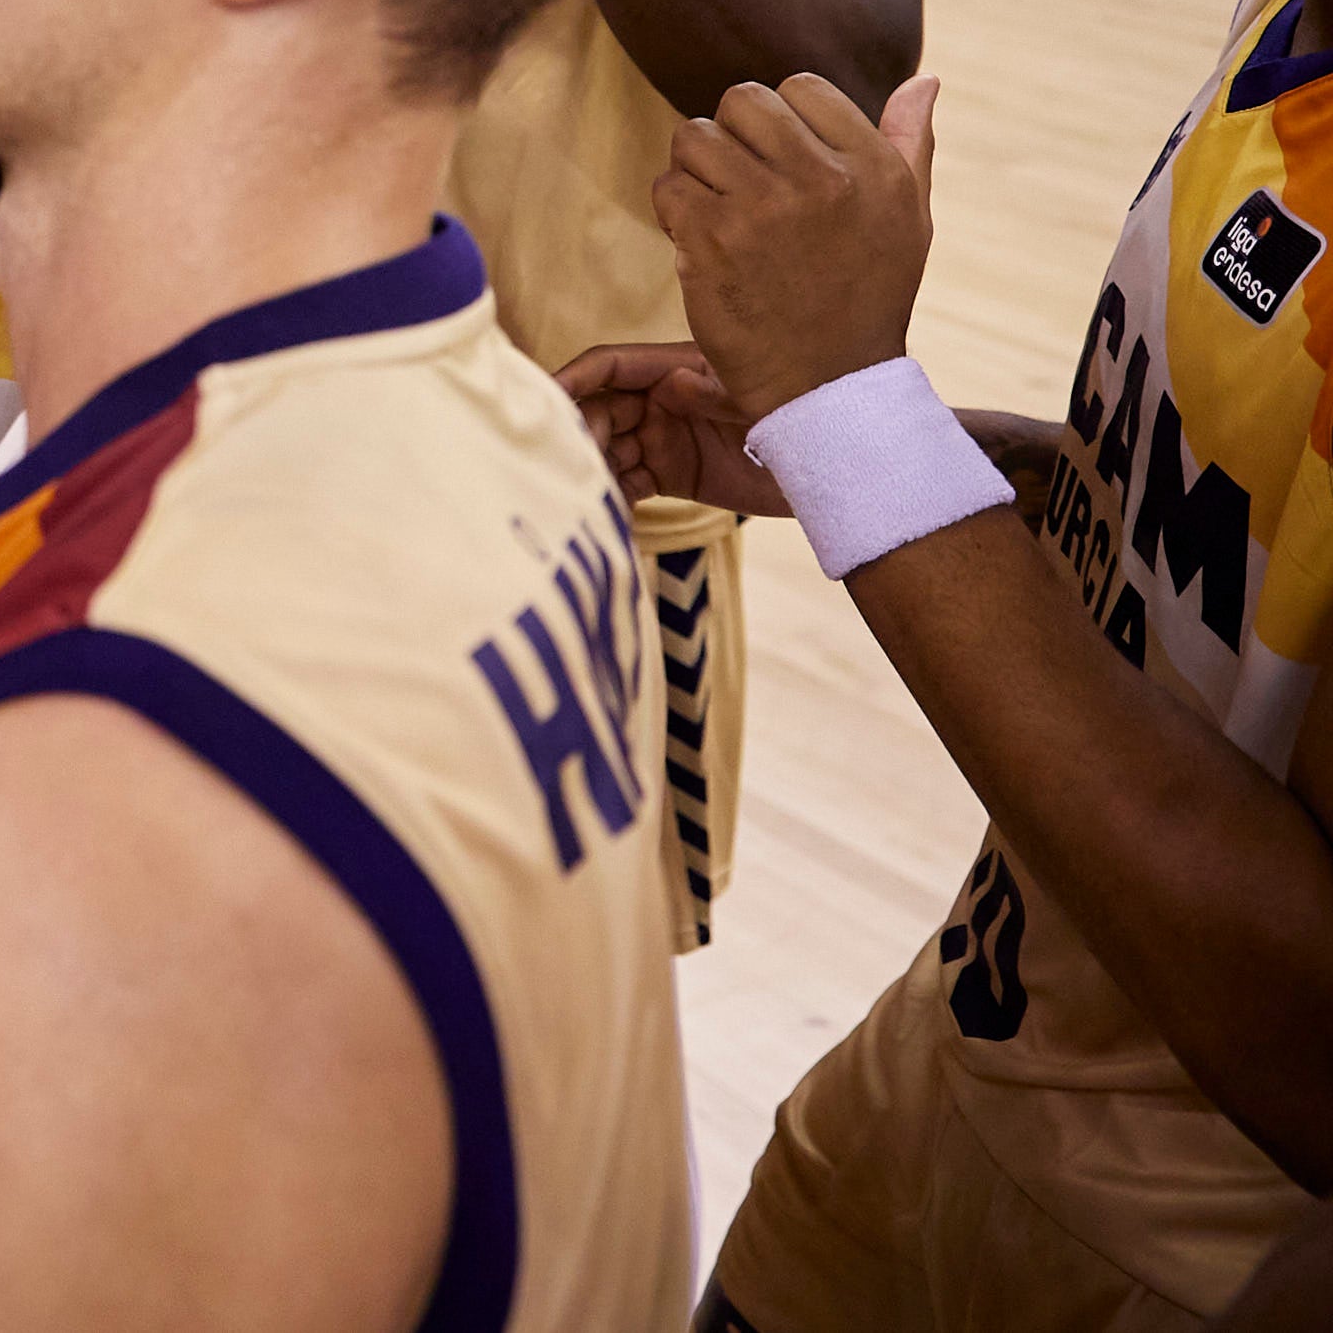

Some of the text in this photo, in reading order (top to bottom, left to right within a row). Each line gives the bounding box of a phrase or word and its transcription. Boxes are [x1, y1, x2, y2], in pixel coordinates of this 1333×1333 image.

[1227, 216, 1258, 256] liga
[1213, 246, 1277, 312] endesa
[1069, 282, 1251, 657] CAM
